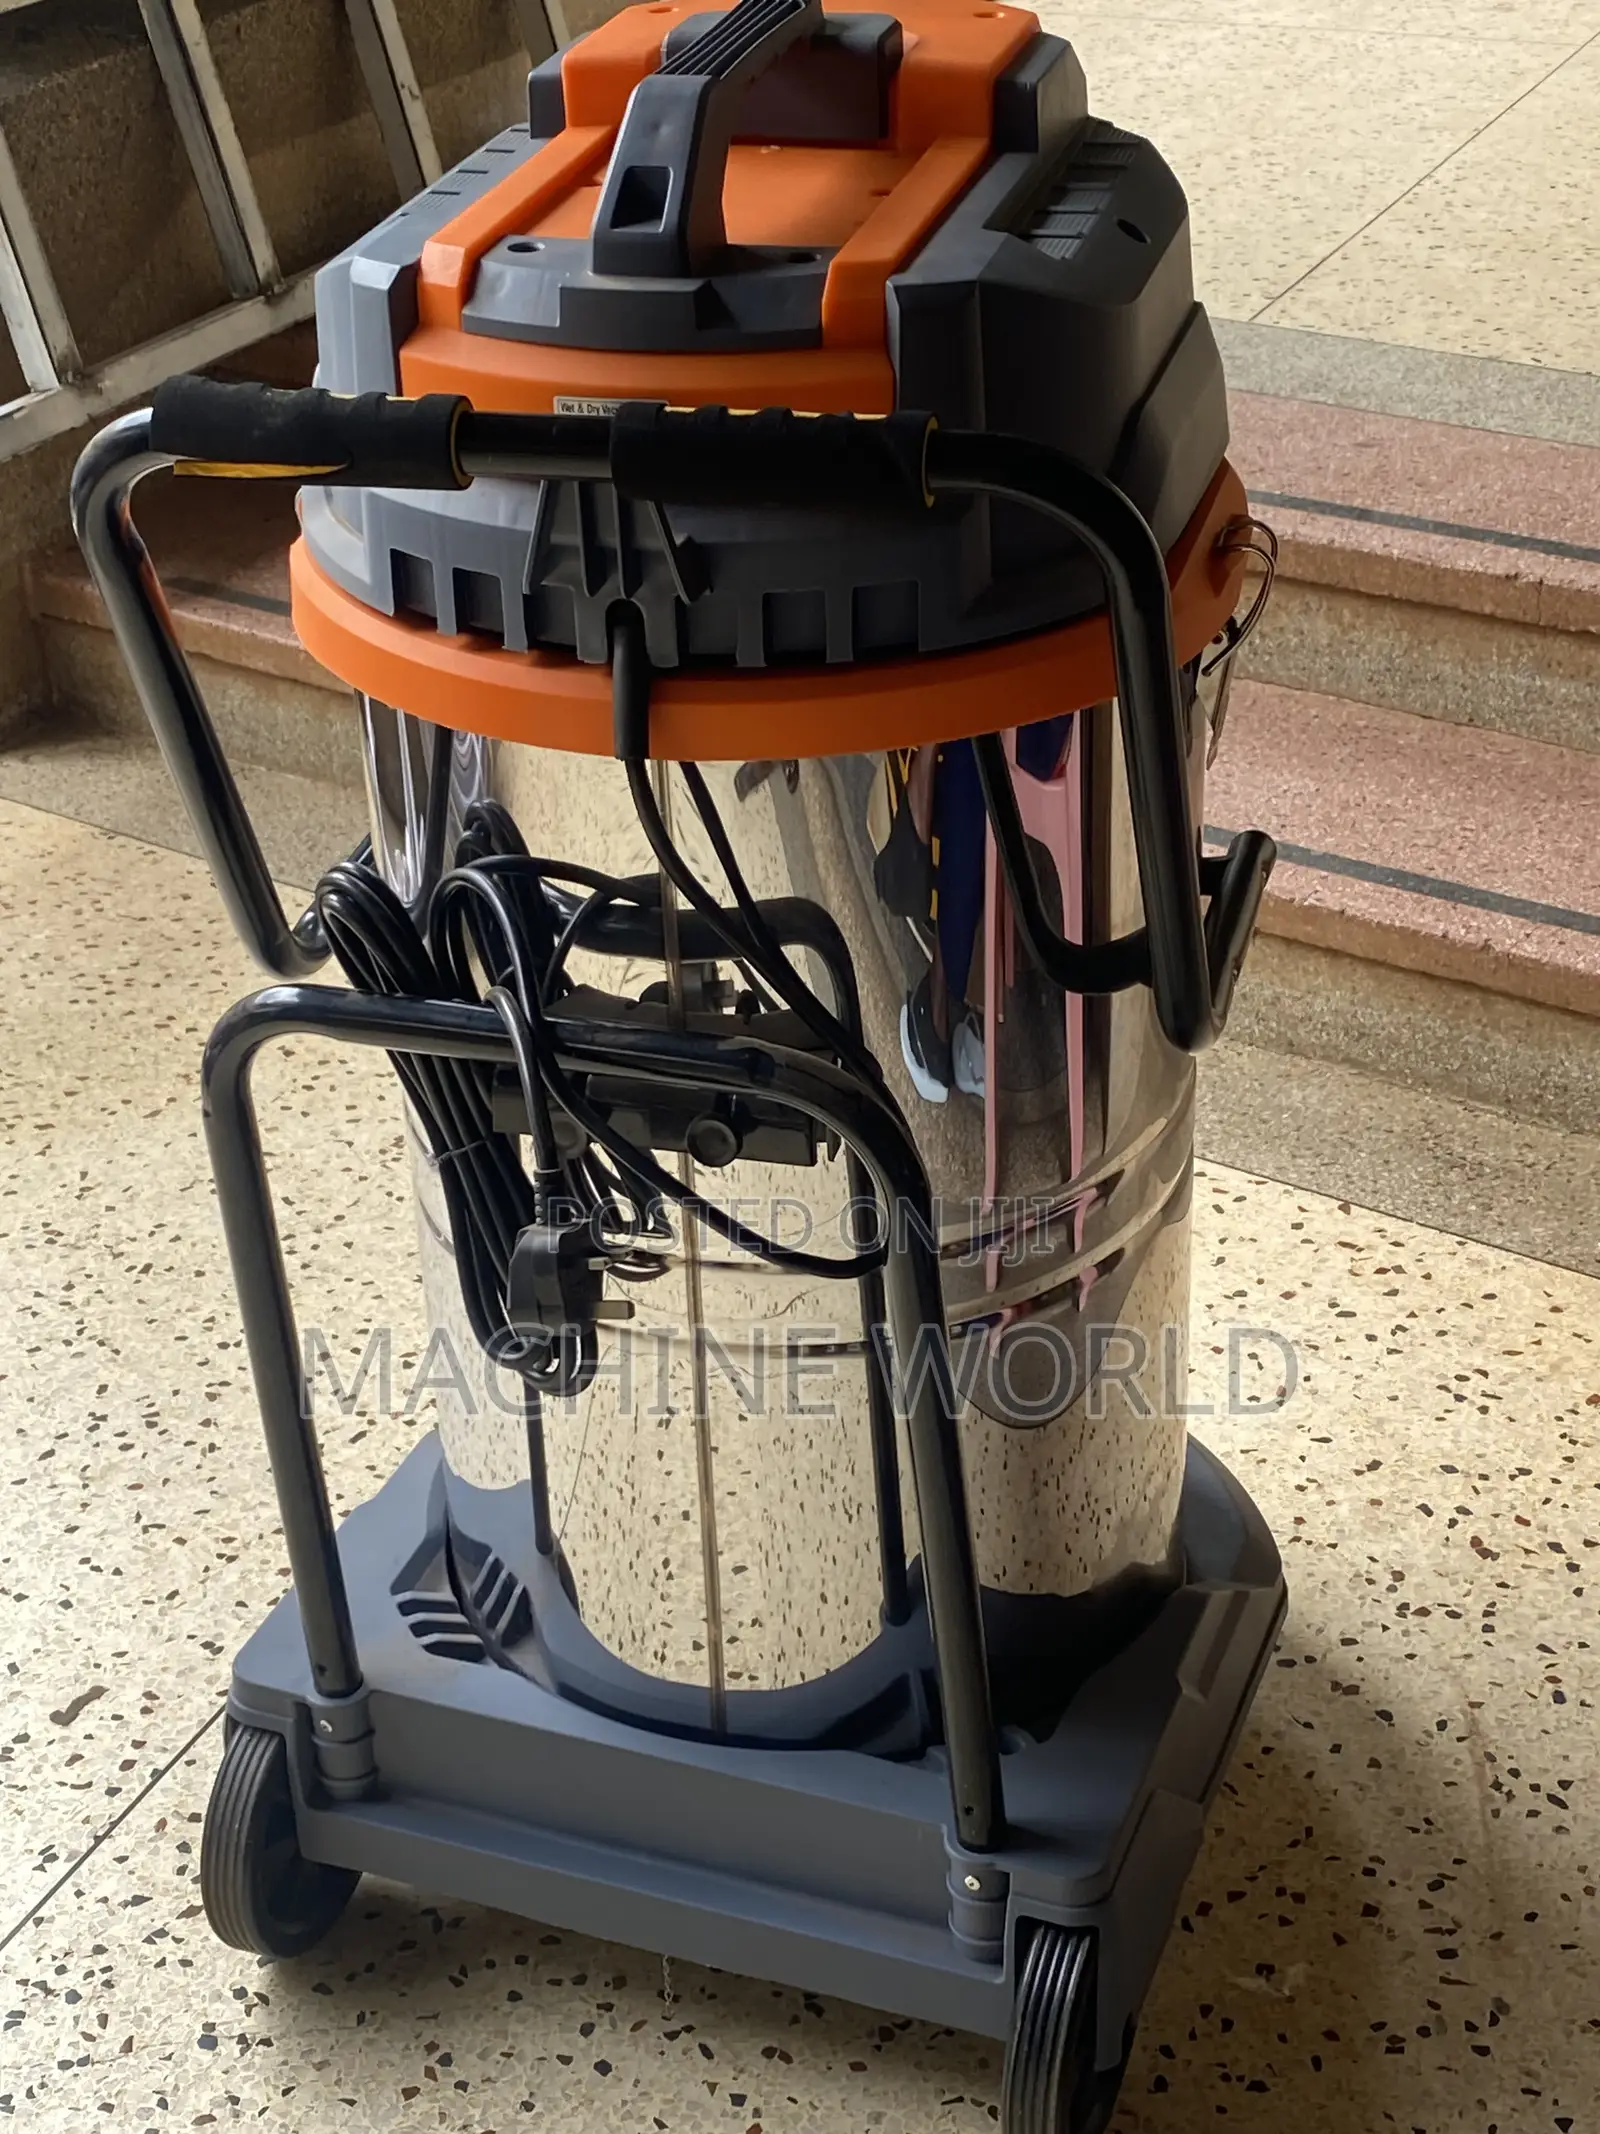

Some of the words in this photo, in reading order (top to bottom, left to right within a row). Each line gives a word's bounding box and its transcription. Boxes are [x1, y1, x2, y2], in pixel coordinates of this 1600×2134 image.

[560, 402, 575, 413] Wet
[577, 402, 585, 414] &
[587, 403, 600, 416] Dry
